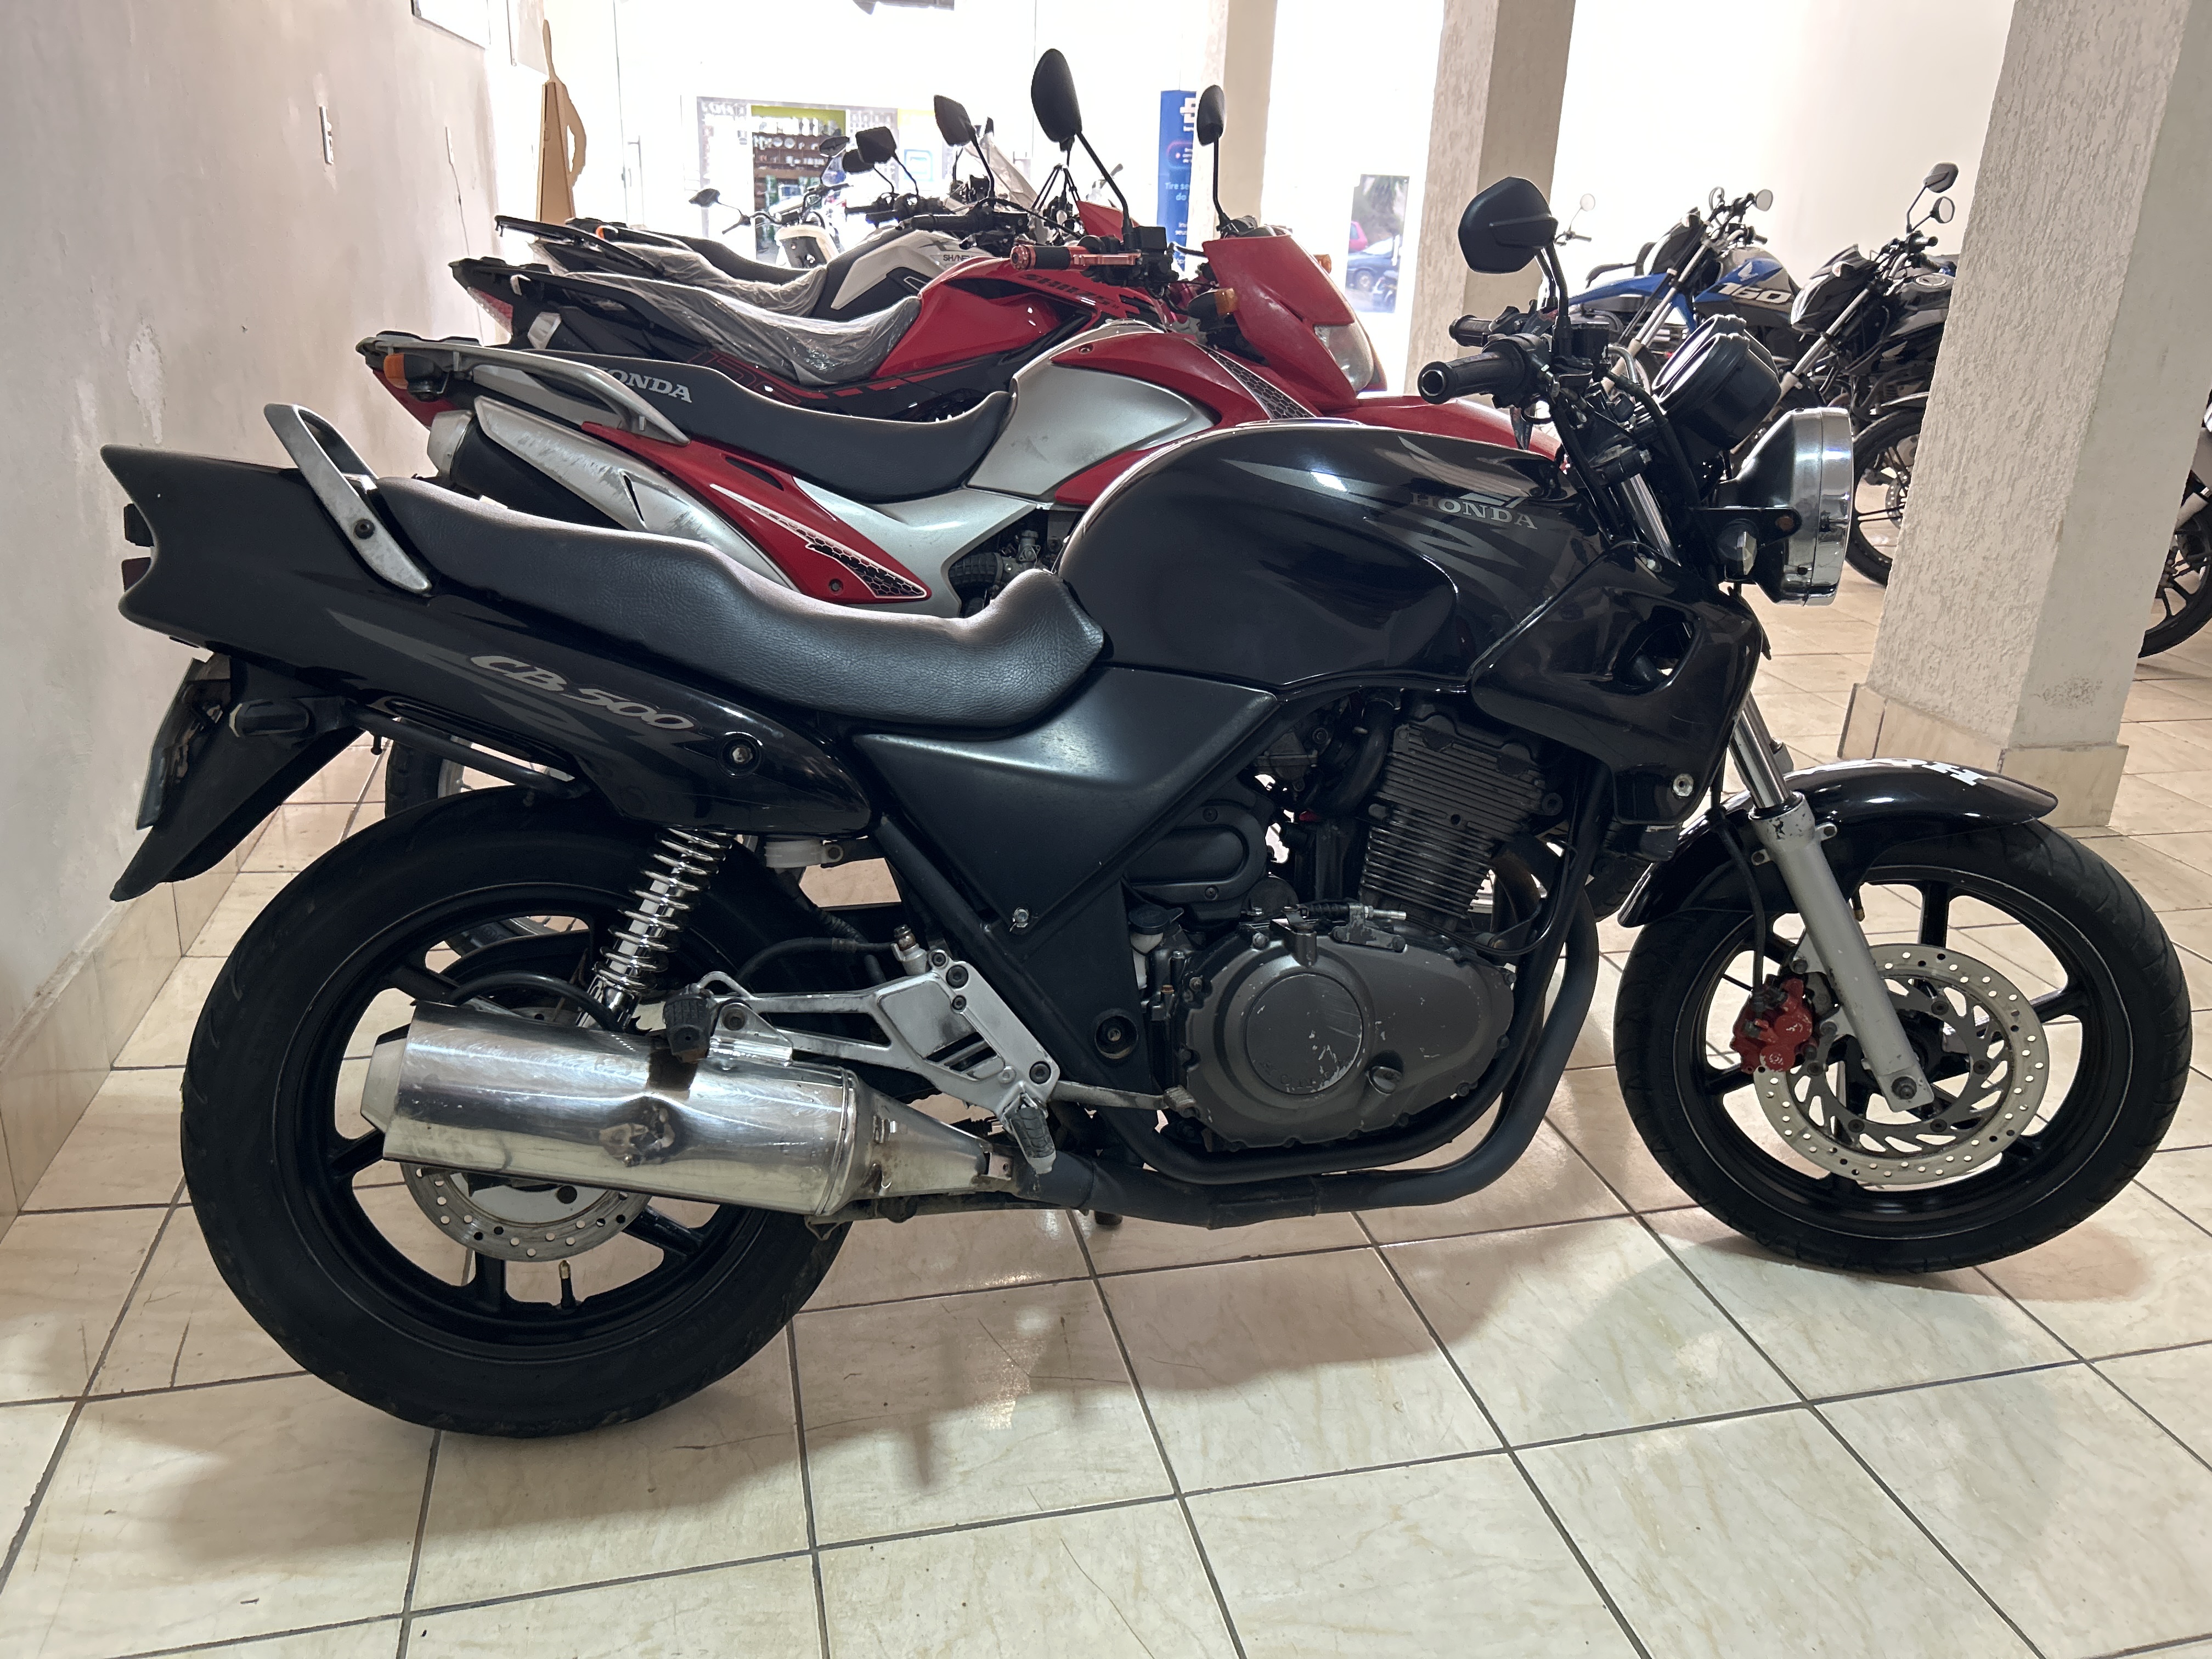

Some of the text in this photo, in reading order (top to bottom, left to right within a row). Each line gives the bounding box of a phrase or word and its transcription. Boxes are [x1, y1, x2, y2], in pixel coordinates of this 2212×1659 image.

[1718, 281, 1792, 304] 160
[597, 366, 693, 403] ONDA
[1410, 492, 1538, 530] HONDA
[470, 655, 696, 730] CB 500
